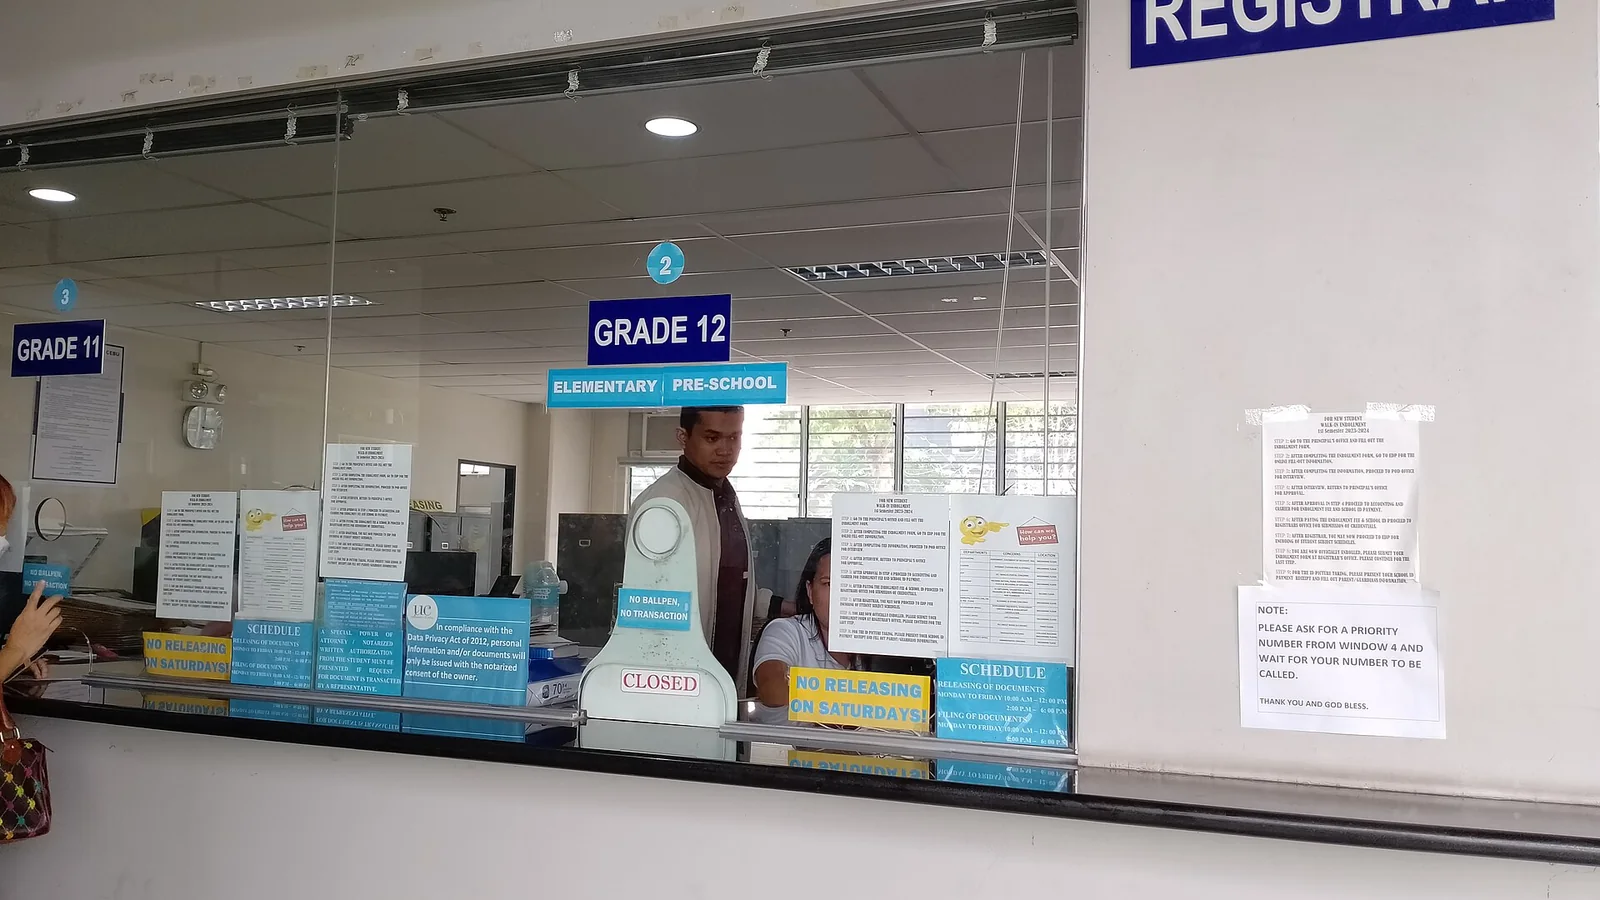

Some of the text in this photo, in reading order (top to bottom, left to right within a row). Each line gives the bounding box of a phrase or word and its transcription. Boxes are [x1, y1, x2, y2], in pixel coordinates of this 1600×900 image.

[660, 256, 672, 275] 2
[61, 289, 69, 304] 3
[594, 315, 726, 346] GRADE 12
[18, 336, 99, 361] GRADE 11
[554, 380, 657, 394] ELEMENTARY
[673, 376, 776, 391] PRE-SCHOOL
[410, 500, 442, 510] ASING
[630, 596, 680, 606] NO BALLPEN,
[621, 609, 687, 620] NO TRANSACTION
[1258, 606, 1288, 615] NOTE:
[247, 624, 300, 636] SCHEDULE
[444, 624, 482, 633] compliance
[1258, 624, 1398, 635] PLEASE ASK FOR A PRIORITY
[147, 639, 161, 649] NO
[165, 640, 226, 653] RELEASING
[424, 635, 448, 643] Privacy
[490, 638, 522, 646] personal
[1258, 639, 1424, 652] NUMBER FROM WINDOW 4 AND
[408, 645, 445, 654] Information
[472, 649, 510, 658] documents
[161, 658, 229, 672] SATURDAYS!
[407, 658, 420, 666] only
[431, 659, 452, 668] issued
[453, 660, 469, 669] with
[470, 661, 482, 669] the
[484, 662, 517, 671] notarized
[1259, 655, 1422, 668] WAIT FOR YOUR NUMBER TO BE
[406, 669, 430, 678] consent
[453, 672, 477, 680] owner.
[961, 663, 1046, 679] SCHEDULE
[1259, 669, 1298, 680] CALLED.
[623, 673, 696, 691] CLOSED
[796, 676, 922, 697] NO RELEASING
[938, 681, 981, 689] RELEASING
[995, 684, 1044, 692] DOCUMENTS
[1260, 698, 1285, 706] THANK
[1344, 702, 1368, 710] BLESS.
[791, 699, 927, 723] ON SATURDAYS!
[978, 714, 1028, 722] DOCUMENTS
